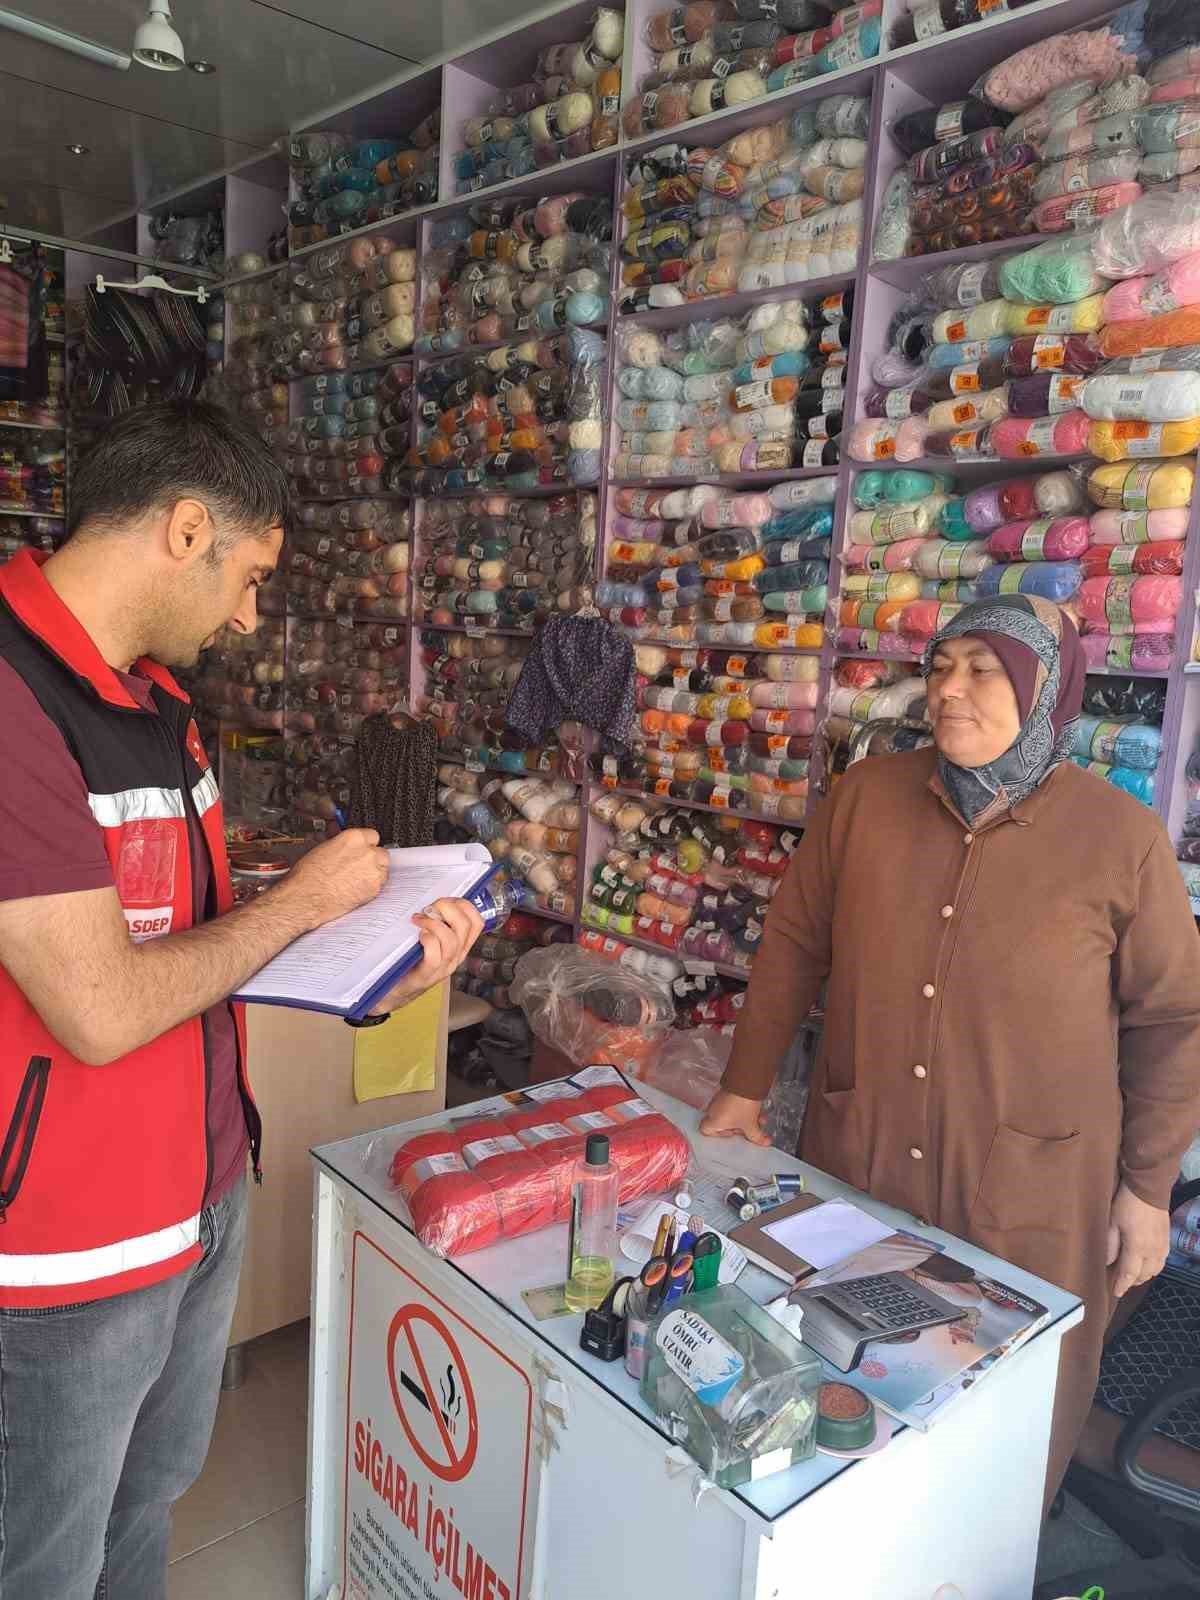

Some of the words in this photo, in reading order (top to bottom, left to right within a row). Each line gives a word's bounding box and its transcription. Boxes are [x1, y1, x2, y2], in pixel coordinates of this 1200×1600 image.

[680, 1311, 715, 1345] SADAKA
[662, 1335, 693, 1369] UZATIR
[354, 1416, 419, 1541] SİGARA
